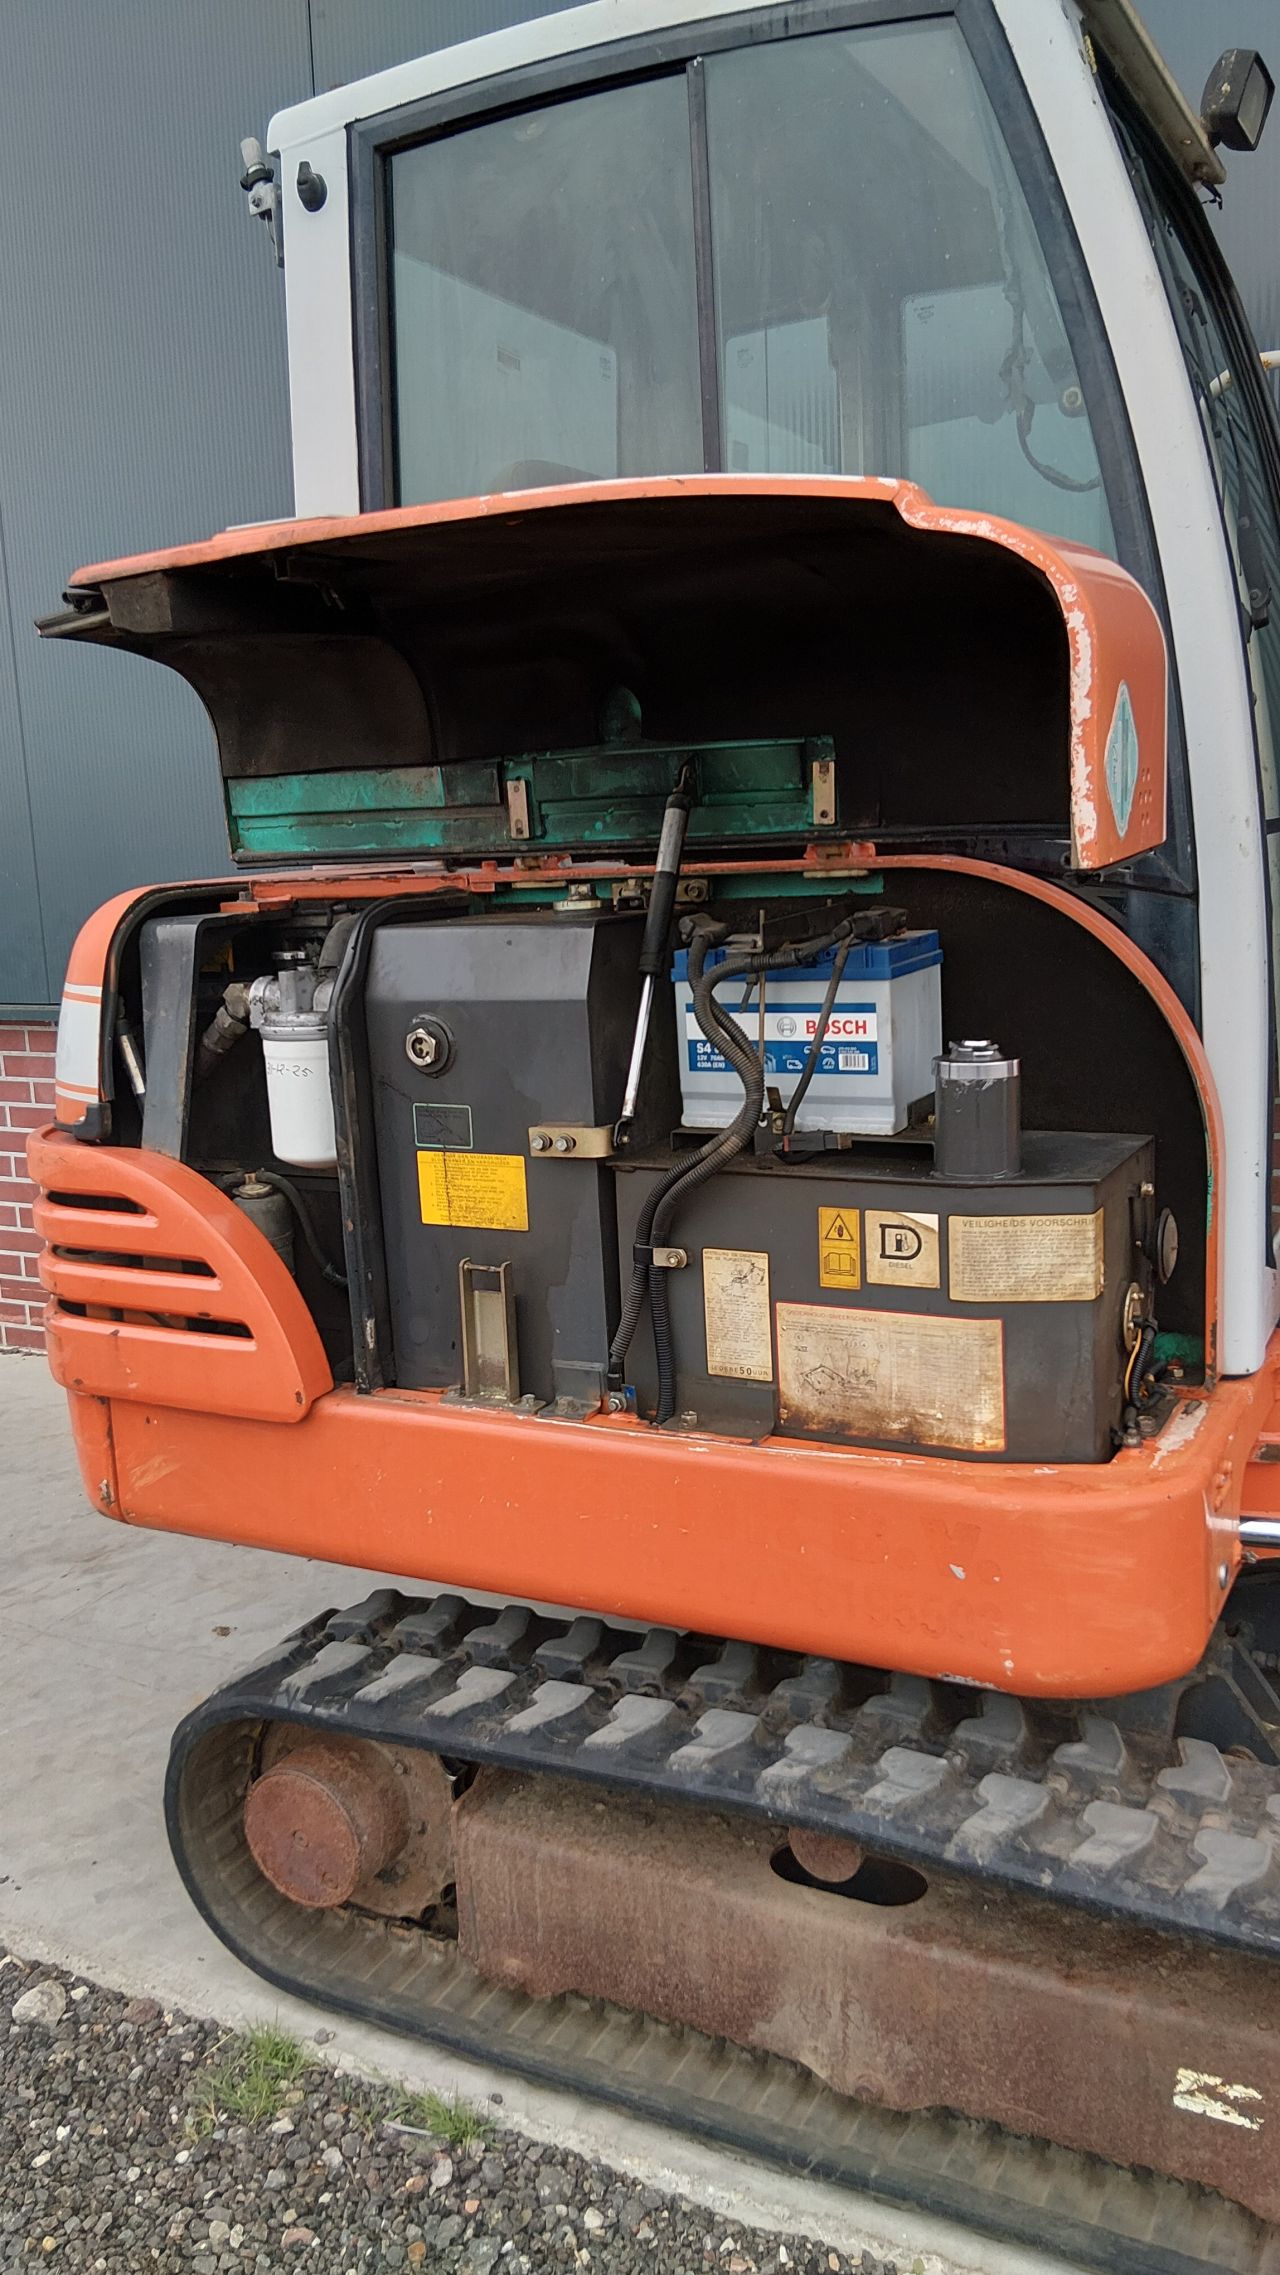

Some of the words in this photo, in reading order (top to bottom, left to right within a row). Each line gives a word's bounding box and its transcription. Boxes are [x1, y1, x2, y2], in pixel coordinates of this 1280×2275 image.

[697, 1042, 711, 1054] S4
[962, 1218, 1026, 1228] VEILIGHEIDS
[888, 1261, 913, 1270] DIESEL
[739, 1366, 752, 1375] 50
